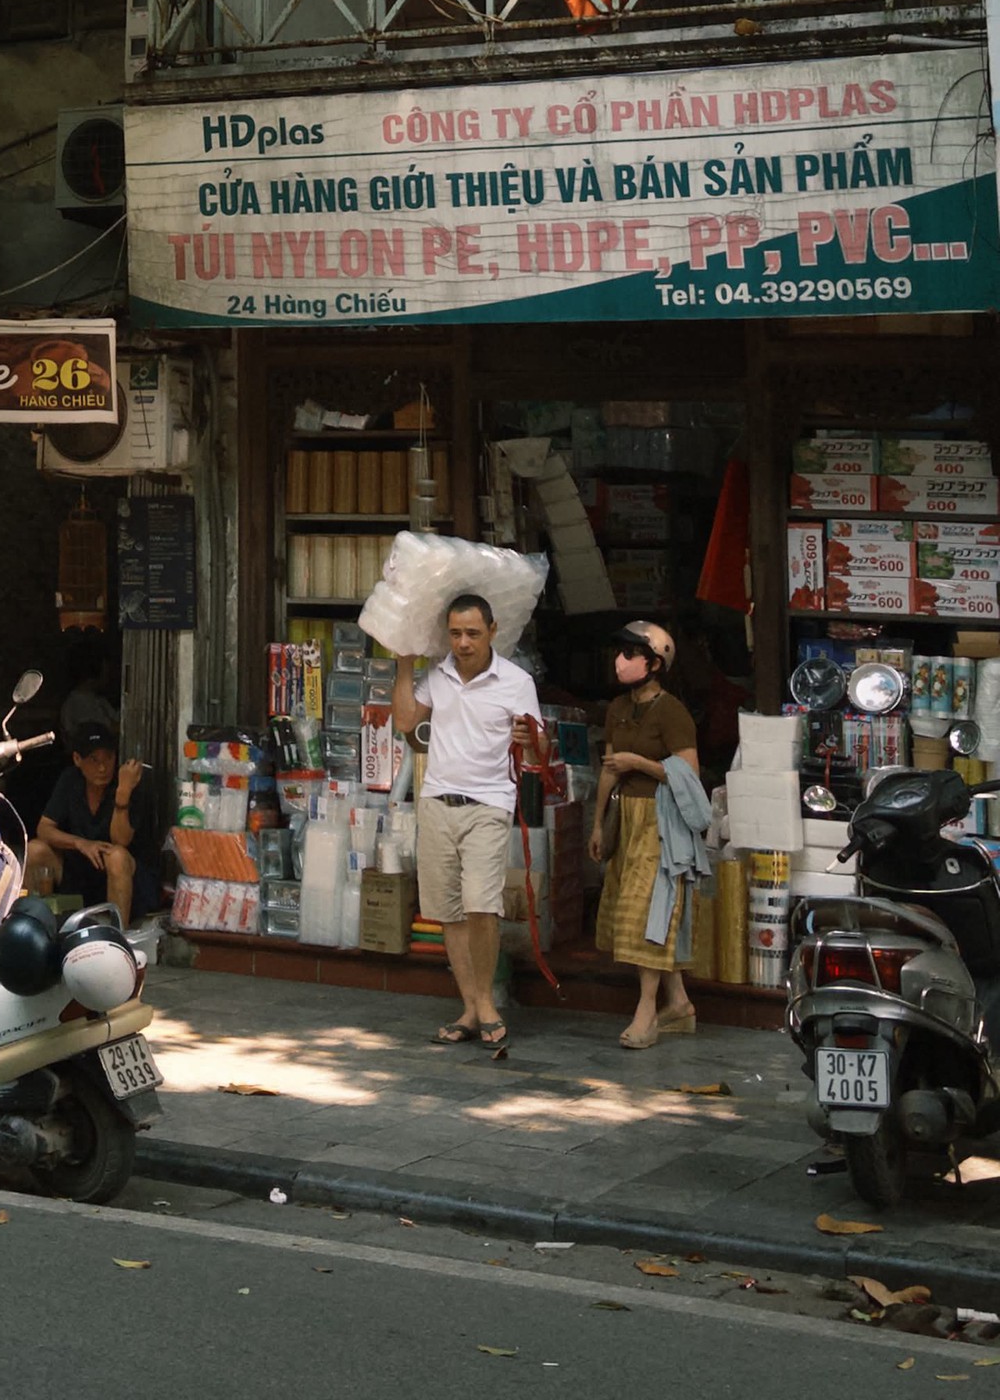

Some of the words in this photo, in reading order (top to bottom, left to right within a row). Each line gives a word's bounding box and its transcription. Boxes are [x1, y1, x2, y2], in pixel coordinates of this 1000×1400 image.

[382, 107, 480, 145] CÔNG
[491, 106, 535, 139] TY
[546, 90, 598, 135] CỔ
[610, 86, 720, 132] PHẦN
[733, 79, 897, 126] HDPLAS
[202, 113, 325, 154] HDplas
[199, 166, 262, 217] CỬA
[270, 171, 358, 214] HÀNG
[369, 163, 436, 211] GIỚI
[446, 162, 545, 214] THIỆU
[555, 158, 603, 203] VÀ
[614, 155, 691, 201] BÁN
[703, 141, 783, 197] SẢN
[795, 133, 914, 192] PHẨM
[167, 221, 236, 281] TÚI
[251, 228, 405, 280] NYLON
[421, 224, 500, 281] PE,
[516, 218, 673, 279] HDPE,
[688, 213, 782, 276] PP,
[227, 296, 257, 315] 24
[264, 294, 327, 318] Hàng
[335, 287, 407, 315] Chiếu
[655, 284, 706, 306] Tel:
[715, 276, 913, 306] 04.39290569
[32, 357, 91, 391] 26
[832, 462, 862, 473] 400
[933, 463, 965, 474] 400
[841, 494, 866, 505] 600
[926, 500, 957, 512] 600
[805, 535, 817, 560] 600
[879, 560, 904, 572] 600
[960, 569, 991, 580] 400
[878, 597, 903, 609] 600
[968, 601, 994, 614] 600
[365, 754, 376, 779] 600
[116, 1061, 157, 1092] 9839
[826, 1053, 878, 1078] 30-K7
[826, 1079, 879, 1103] 4005
